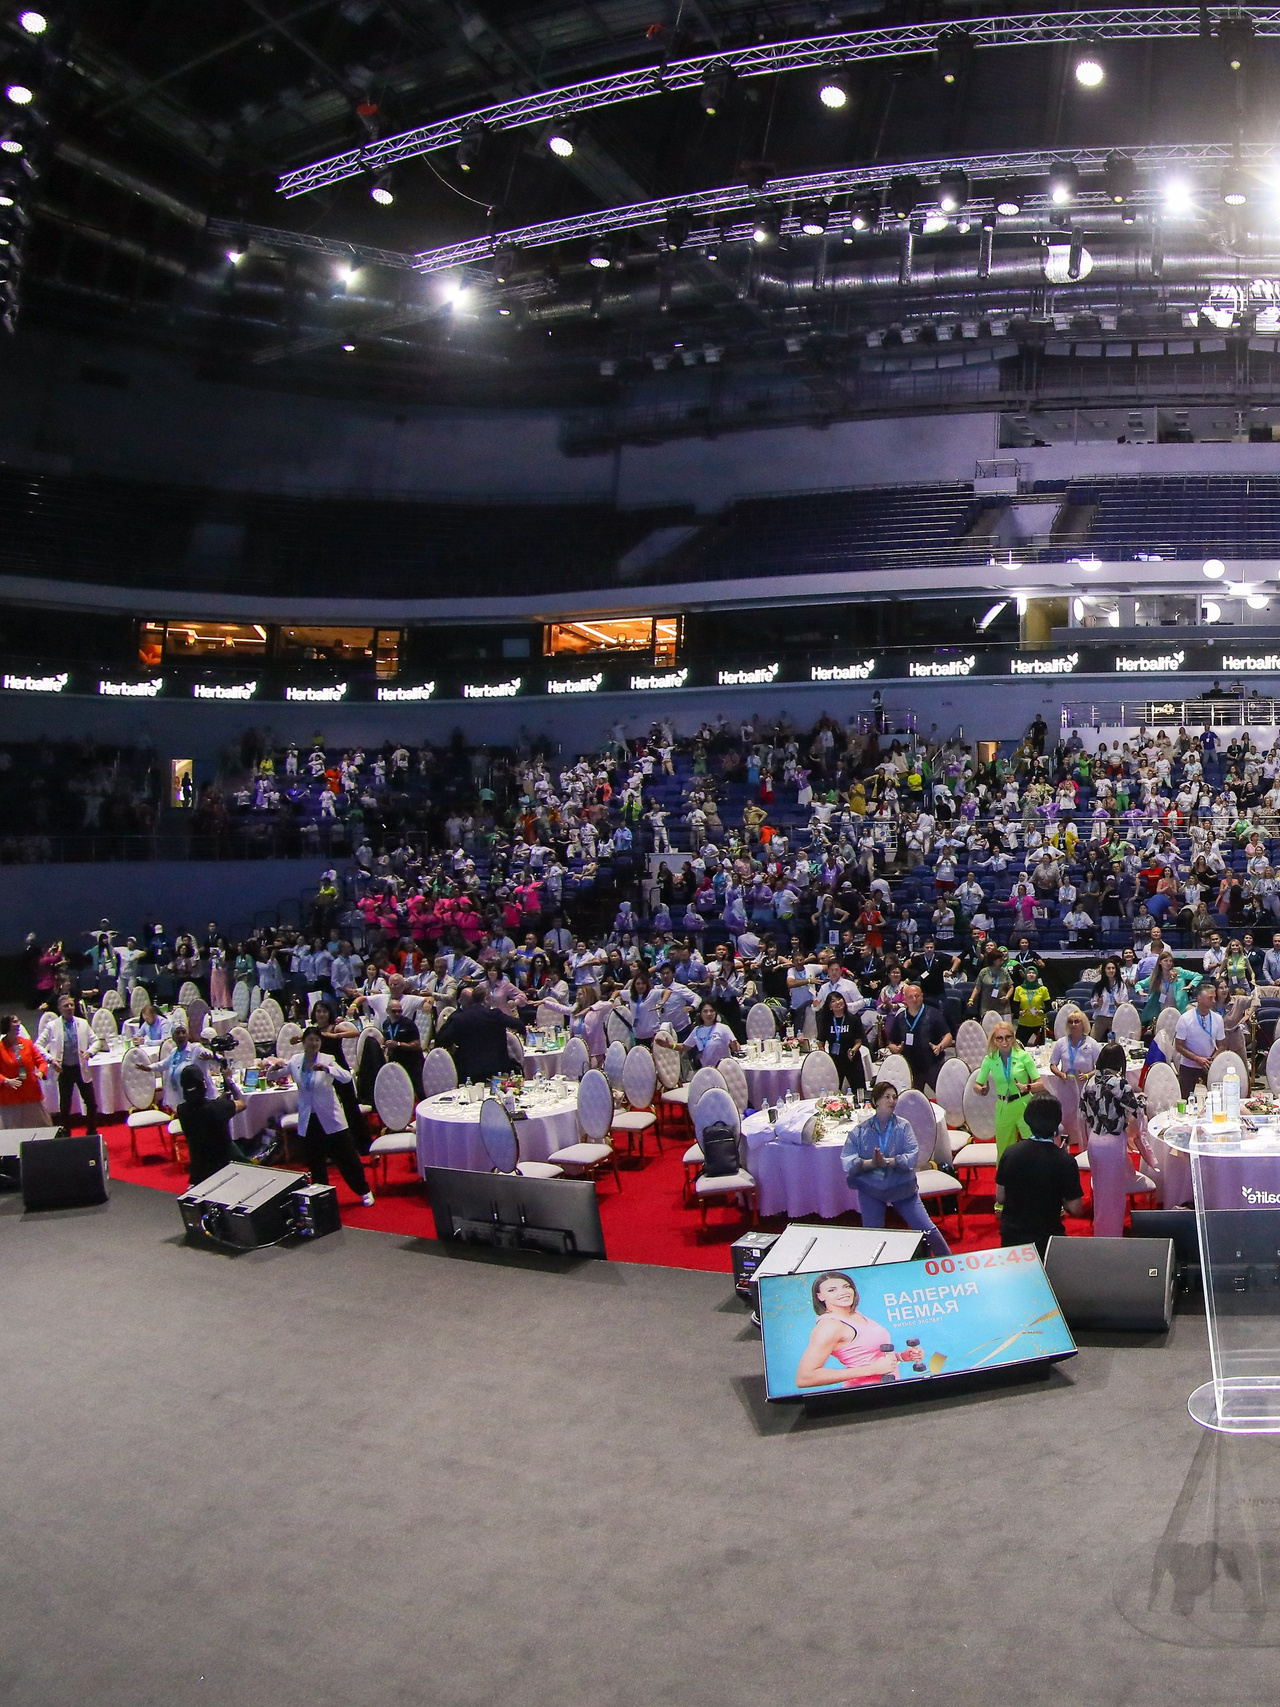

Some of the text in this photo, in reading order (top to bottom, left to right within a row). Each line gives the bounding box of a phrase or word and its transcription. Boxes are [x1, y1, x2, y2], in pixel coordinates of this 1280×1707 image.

[910, 661, 970, 678] Herbalife
[1011, 658, 1073, 674] Herbalife
[1116, 656, 1179, 672] Herbalife
[719, 669, 773, 684] Herbalife
[812, 665, 869, 680] Herbalife
[5, 675, 62, 692] Herbalife
[100, 681, 157, 696] Herbalife
[548, 678, 597, 693] Herbalife
[631, 674, 683, 689] Herbalife
[195, 685, 251, 699] Herbalife
[287, 688, 341, 701] Herbalife
[378, 687, 430, 700] Herbalife
[464, 683, 516, 697] Herbalife
[924, 1247, 1037, 1276] 00:02:45
[883, 1281, 979, 1307] ВАЛЕРИЯ
[886, 1299, 960, 1322] НЕМАЯ
